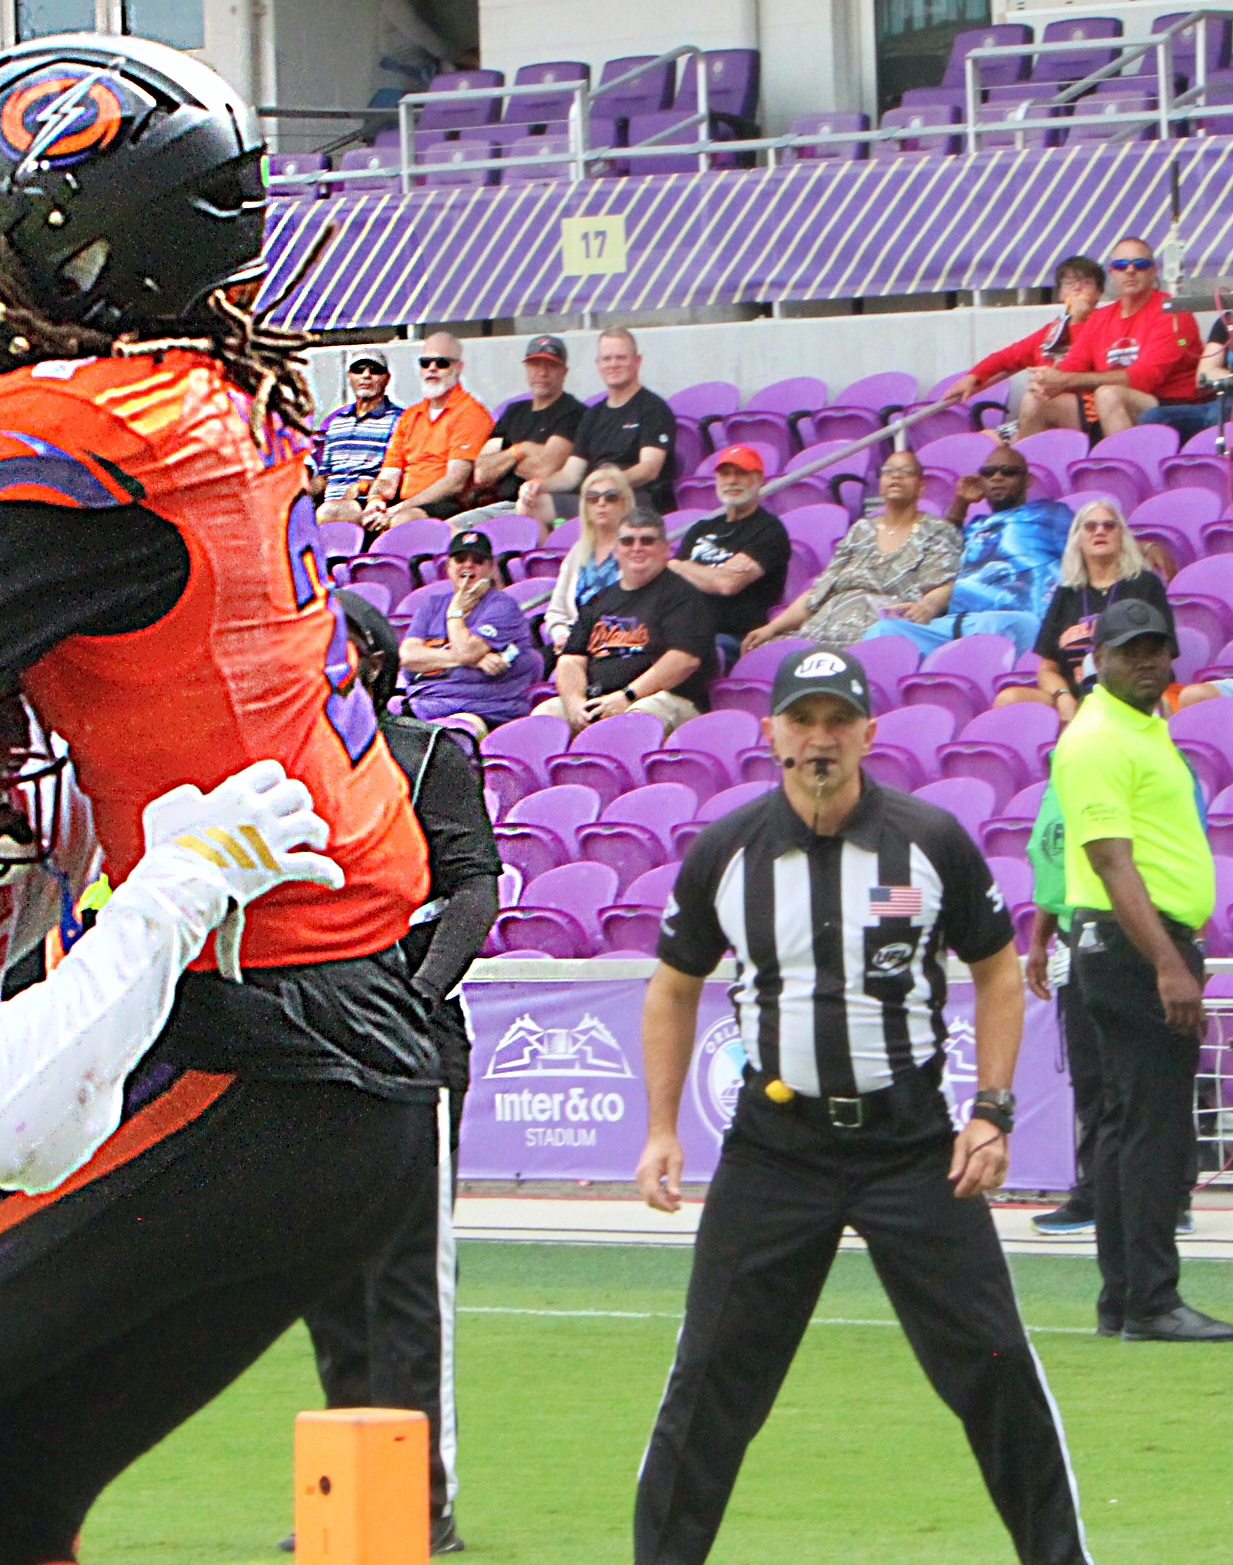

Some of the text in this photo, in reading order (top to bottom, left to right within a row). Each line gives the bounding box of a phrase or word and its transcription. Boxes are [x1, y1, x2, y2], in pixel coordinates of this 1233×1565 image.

[580, 230, 607, 259] 17
[799, 659, 838, 674] UFL
[525, 1127, 597, 1147] STADIUM
